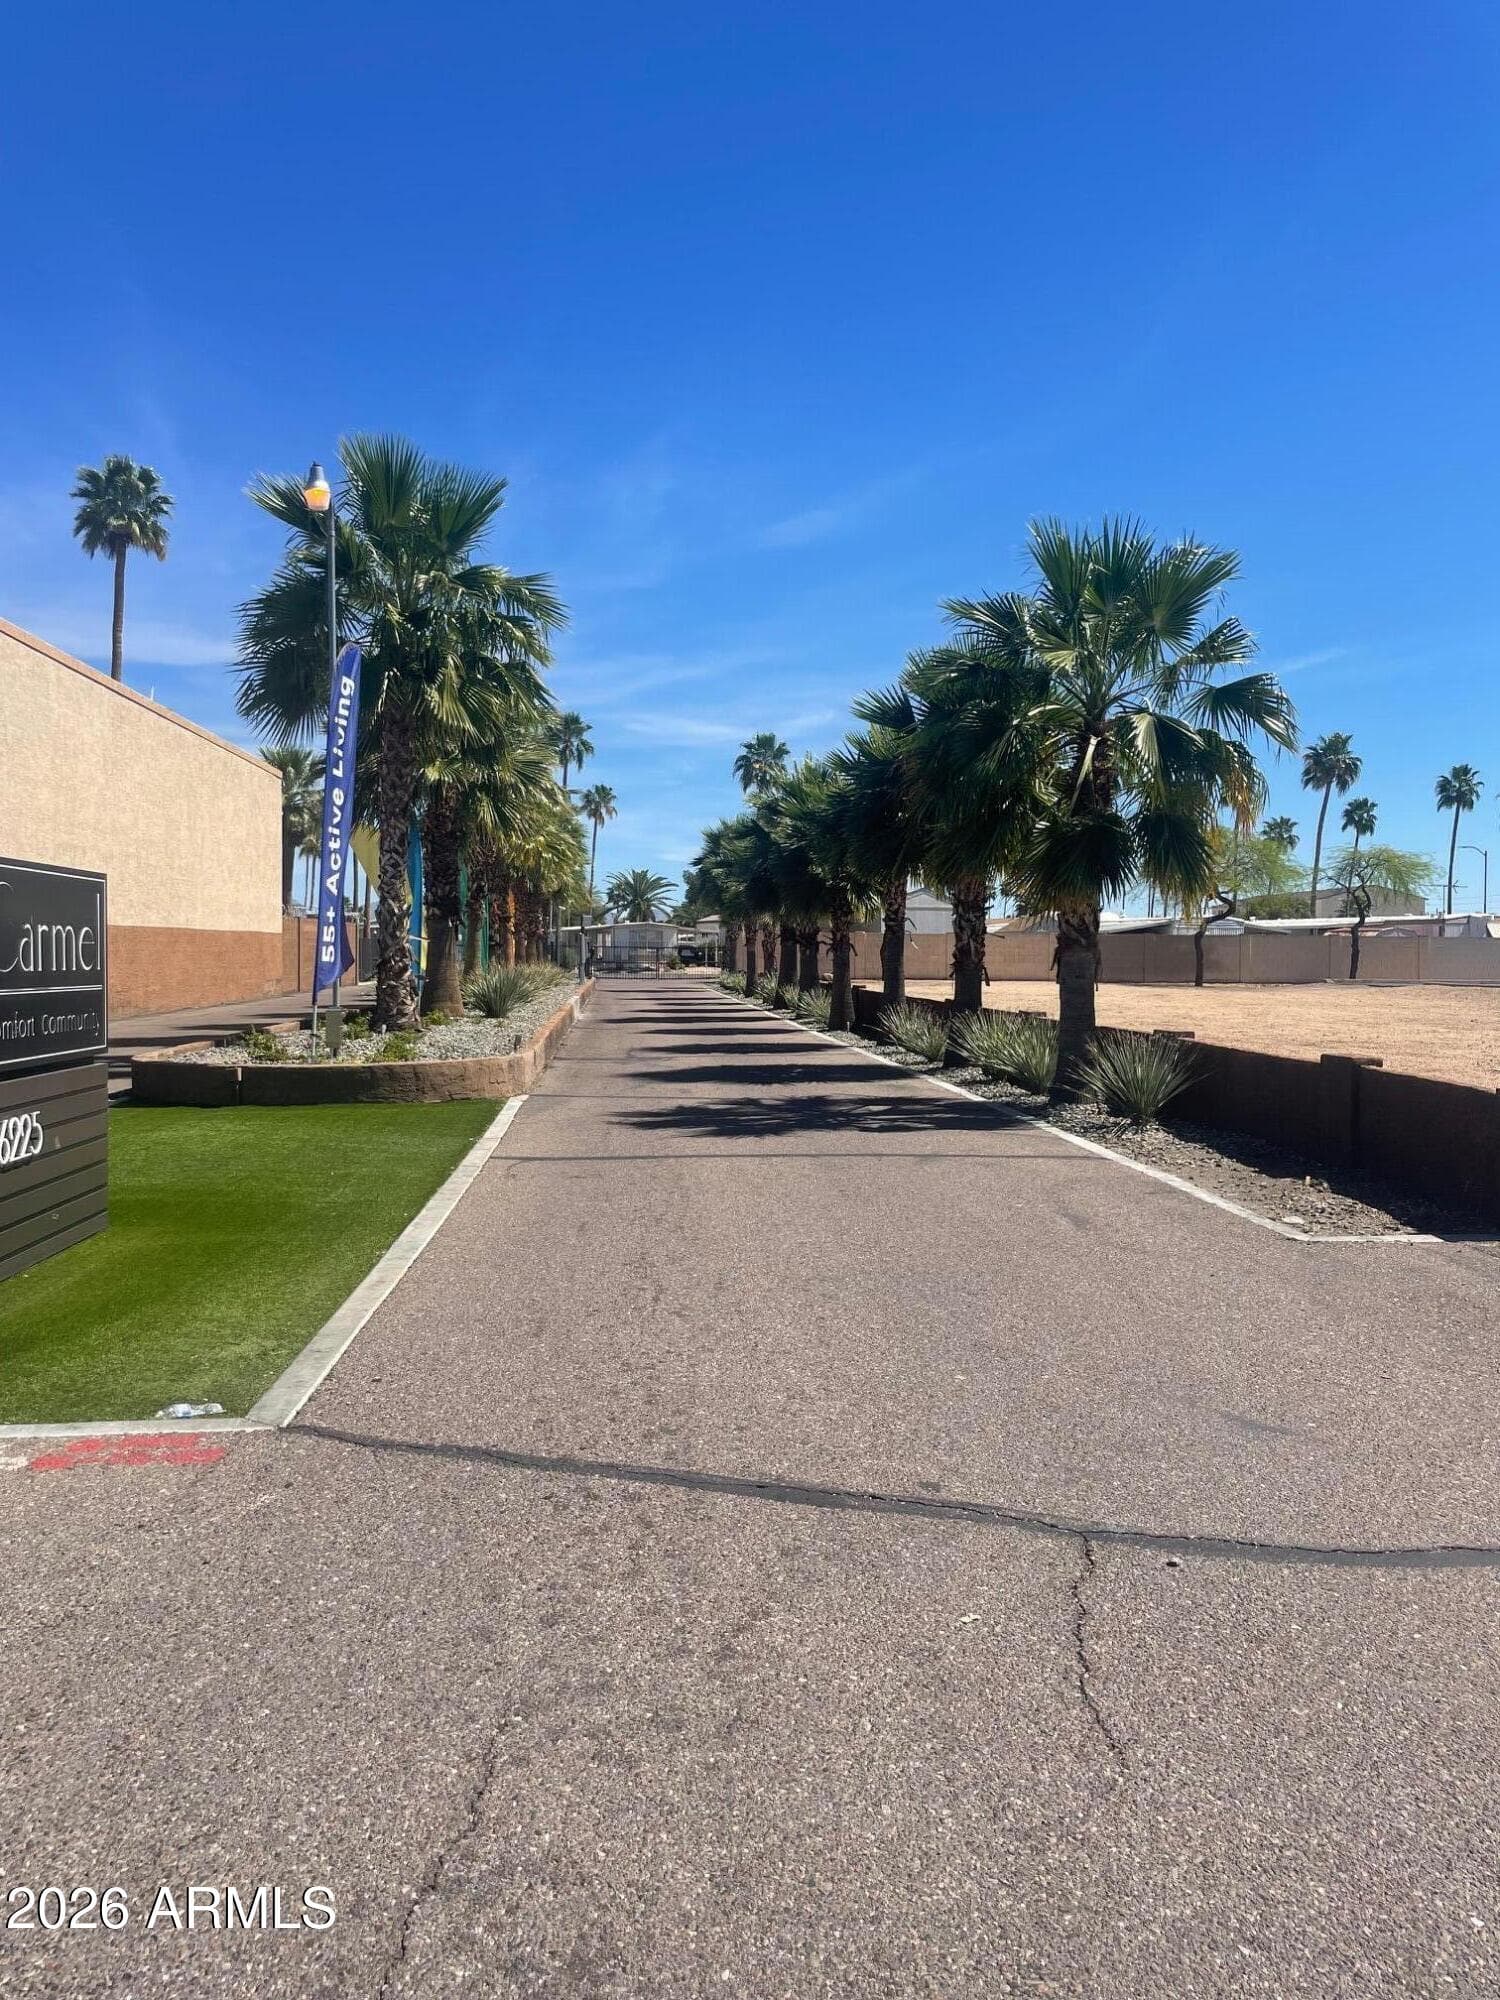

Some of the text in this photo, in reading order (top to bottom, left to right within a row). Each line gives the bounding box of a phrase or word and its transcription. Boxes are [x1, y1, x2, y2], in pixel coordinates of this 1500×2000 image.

[321, 675, 355, 963] 55+ Active Living
[0, 1011, 100, 1040] mfort Communy
